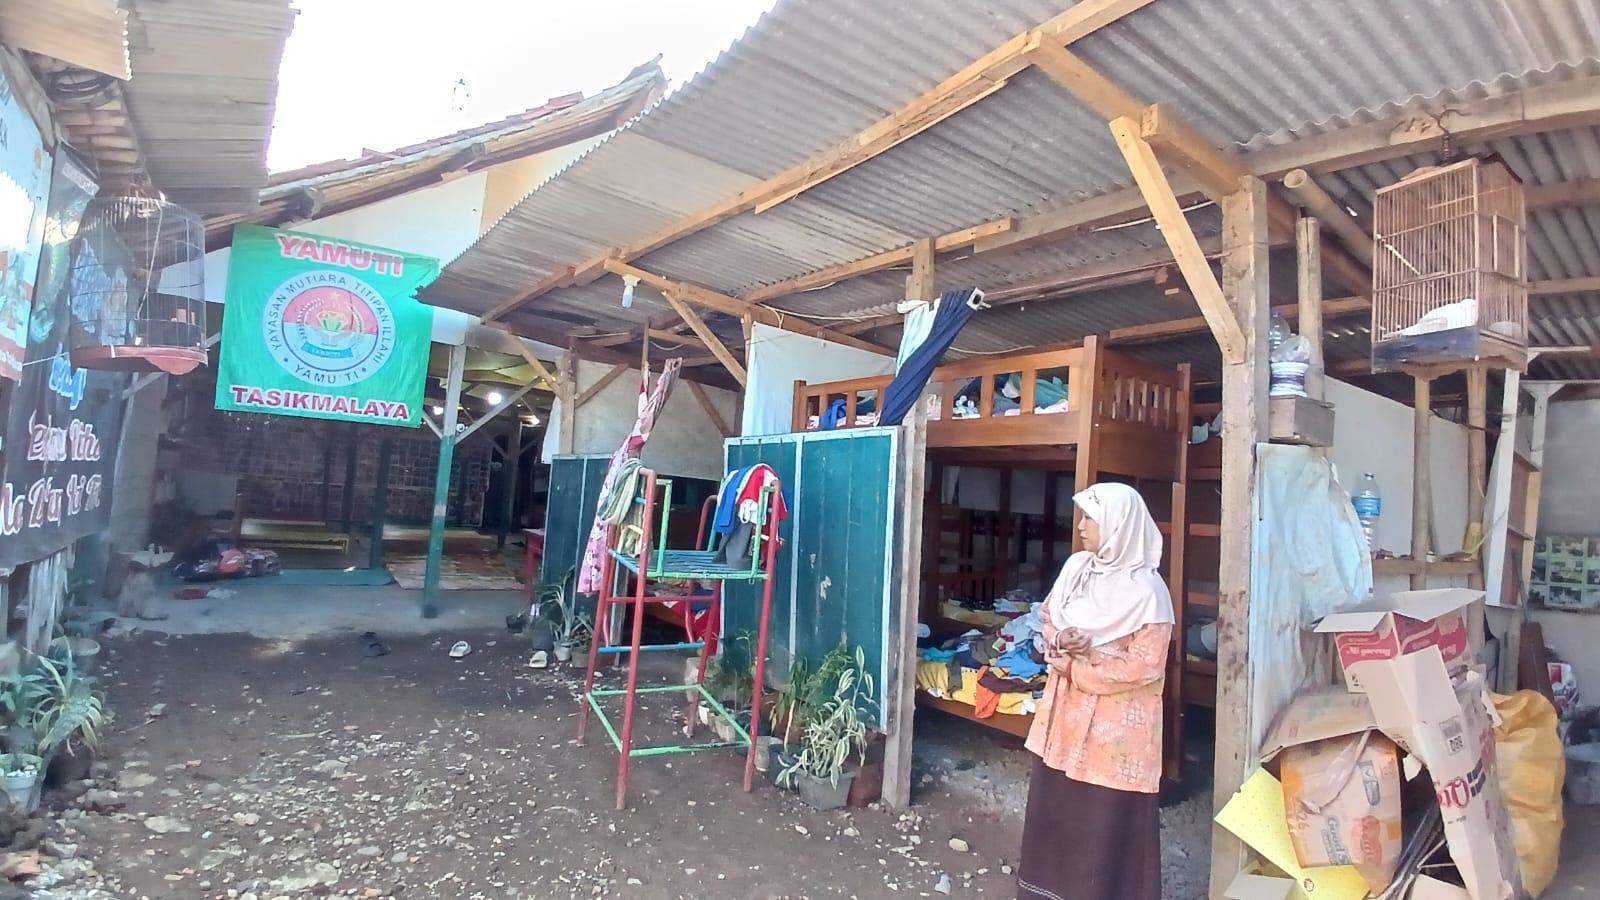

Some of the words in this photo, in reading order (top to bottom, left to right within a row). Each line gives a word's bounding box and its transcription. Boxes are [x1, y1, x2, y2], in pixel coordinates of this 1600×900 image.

[277, 234, 404, 277] YAMUTI
[267, 294, 287, 351] YAYASAN
[285, 273, 347, 294] MUTIARA
[353, 282, 390, 321] TITIPAN
[372, 326, 392, 364] ILLAHI
[231, 385, 409, 420] TASIKMALAYA
